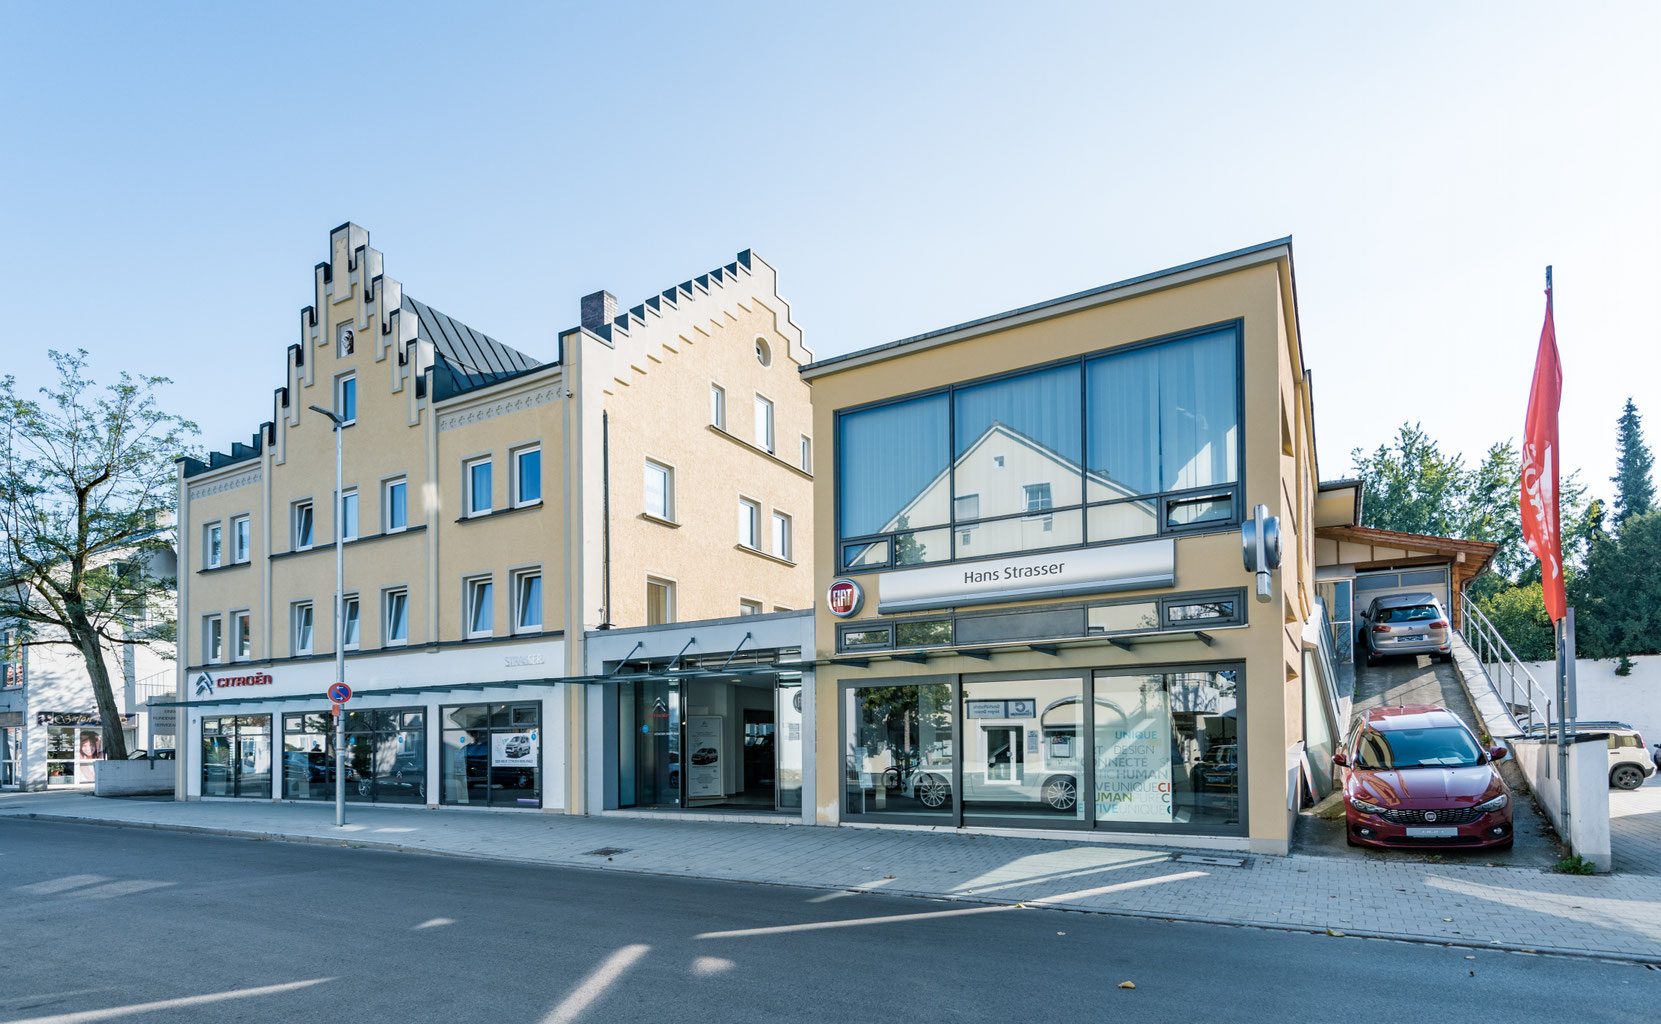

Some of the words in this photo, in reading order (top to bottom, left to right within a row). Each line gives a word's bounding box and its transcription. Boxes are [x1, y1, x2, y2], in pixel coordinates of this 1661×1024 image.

[964, 571, 1000, 583] Hans
[1004, 563, 1065, 580] Strasser
[832, 588, 853, 607] FIAT
[504, 654, 545, 667] STRASSER
[1115, 730, 1158, 740] UNIQUE
[1113, 745, 1155, 755] DESIGN
